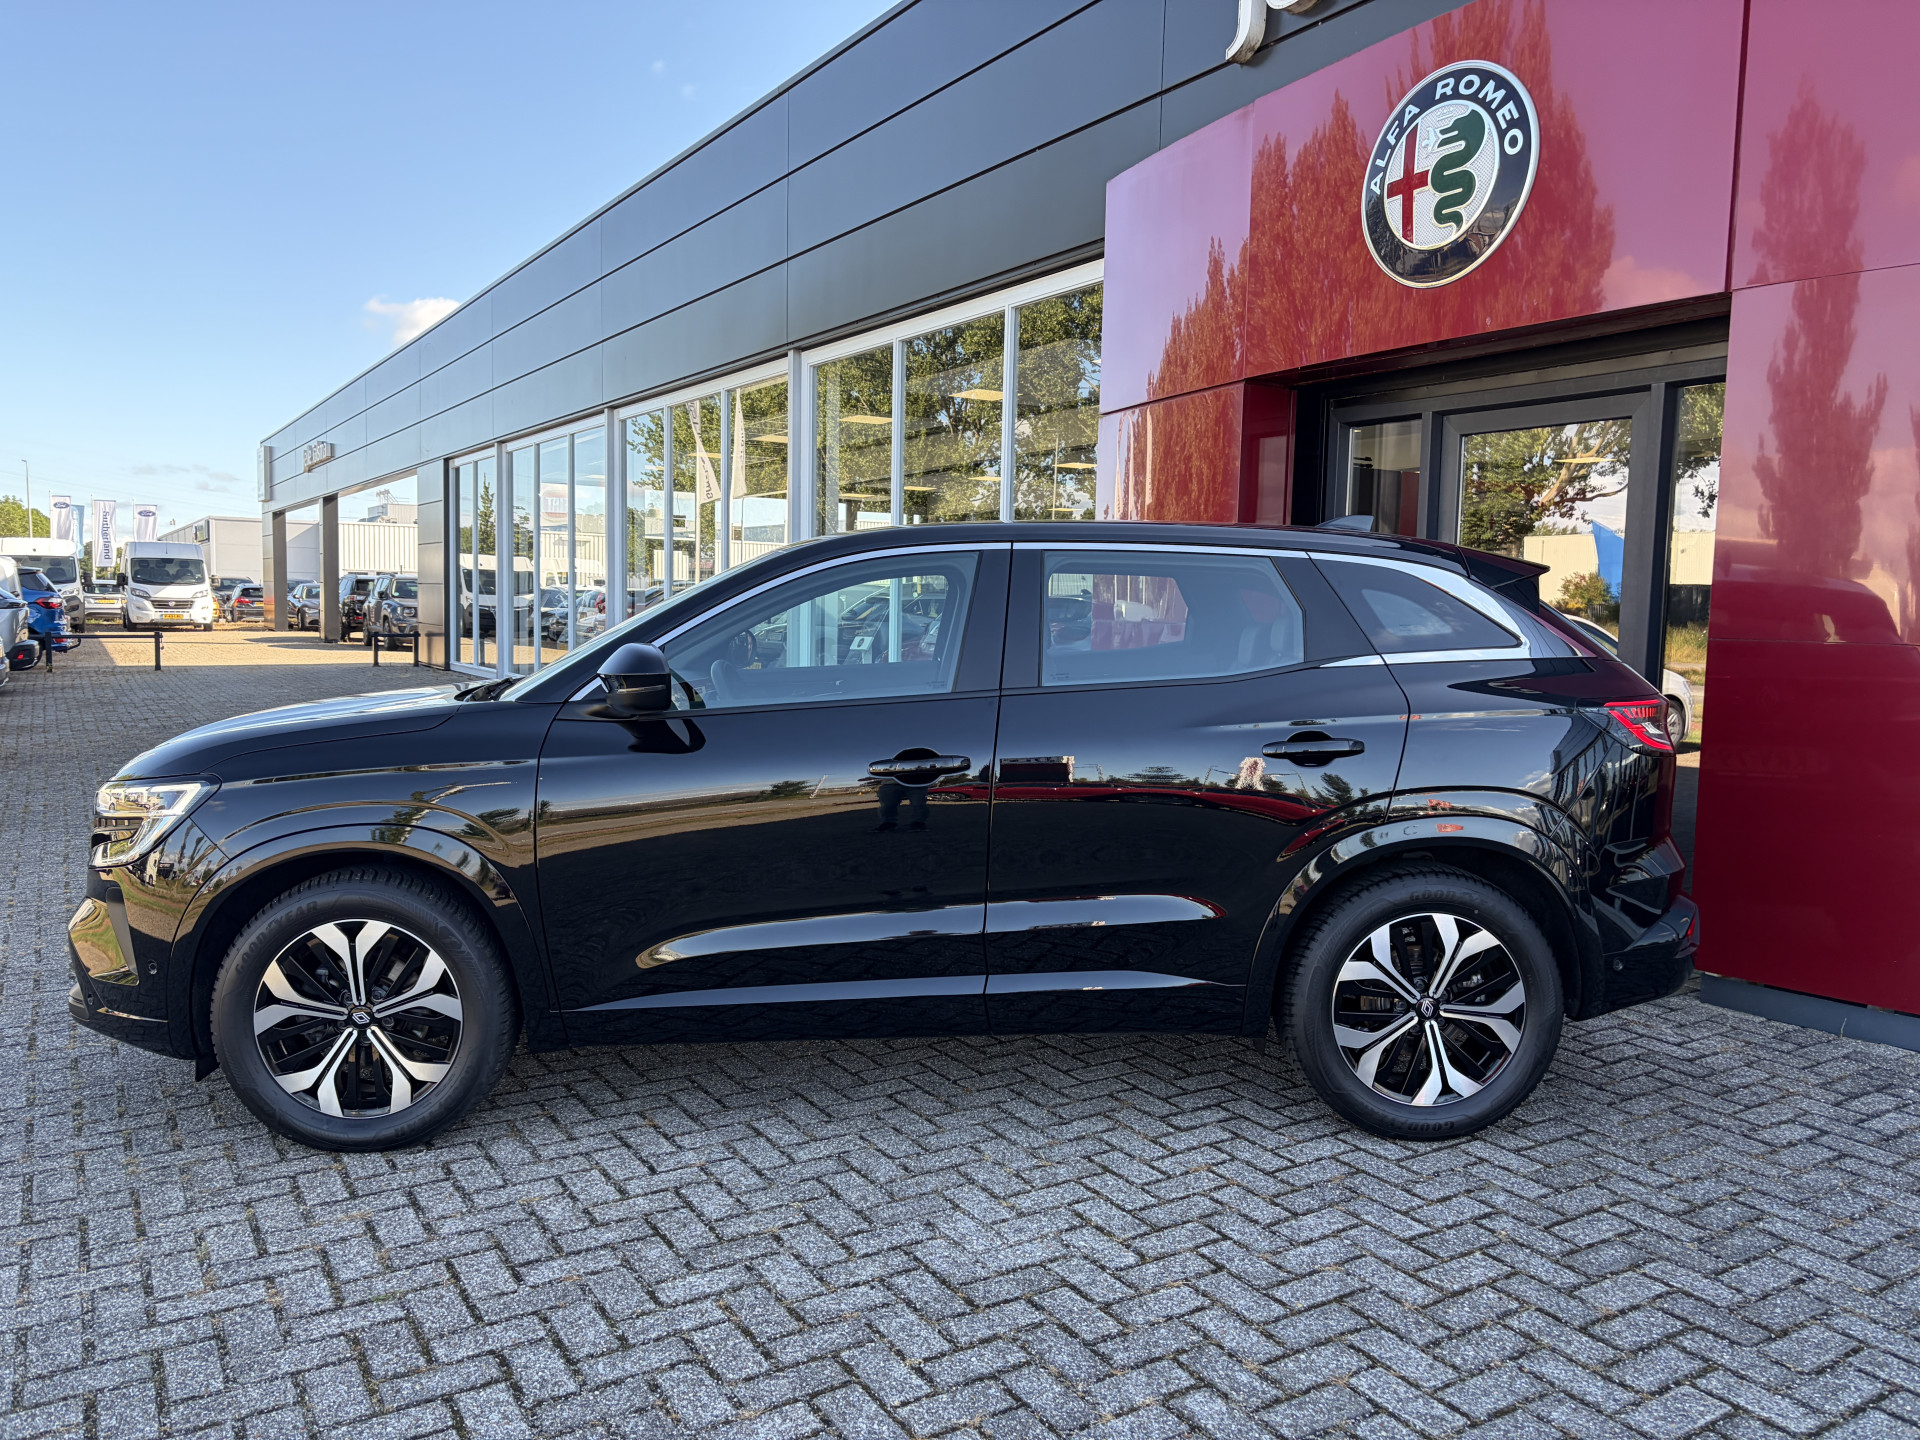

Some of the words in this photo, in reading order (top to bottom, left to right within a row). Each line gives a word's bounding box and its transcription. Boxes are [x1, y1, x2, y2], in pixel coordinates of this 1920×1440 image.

[1370, 103, 1421, 195] ALFA
[1434, 74, 1524, 156] ROMEO
[102, 510, 112, 560] Sutherland
[234, 899, 319, 976] GOODYEAR
